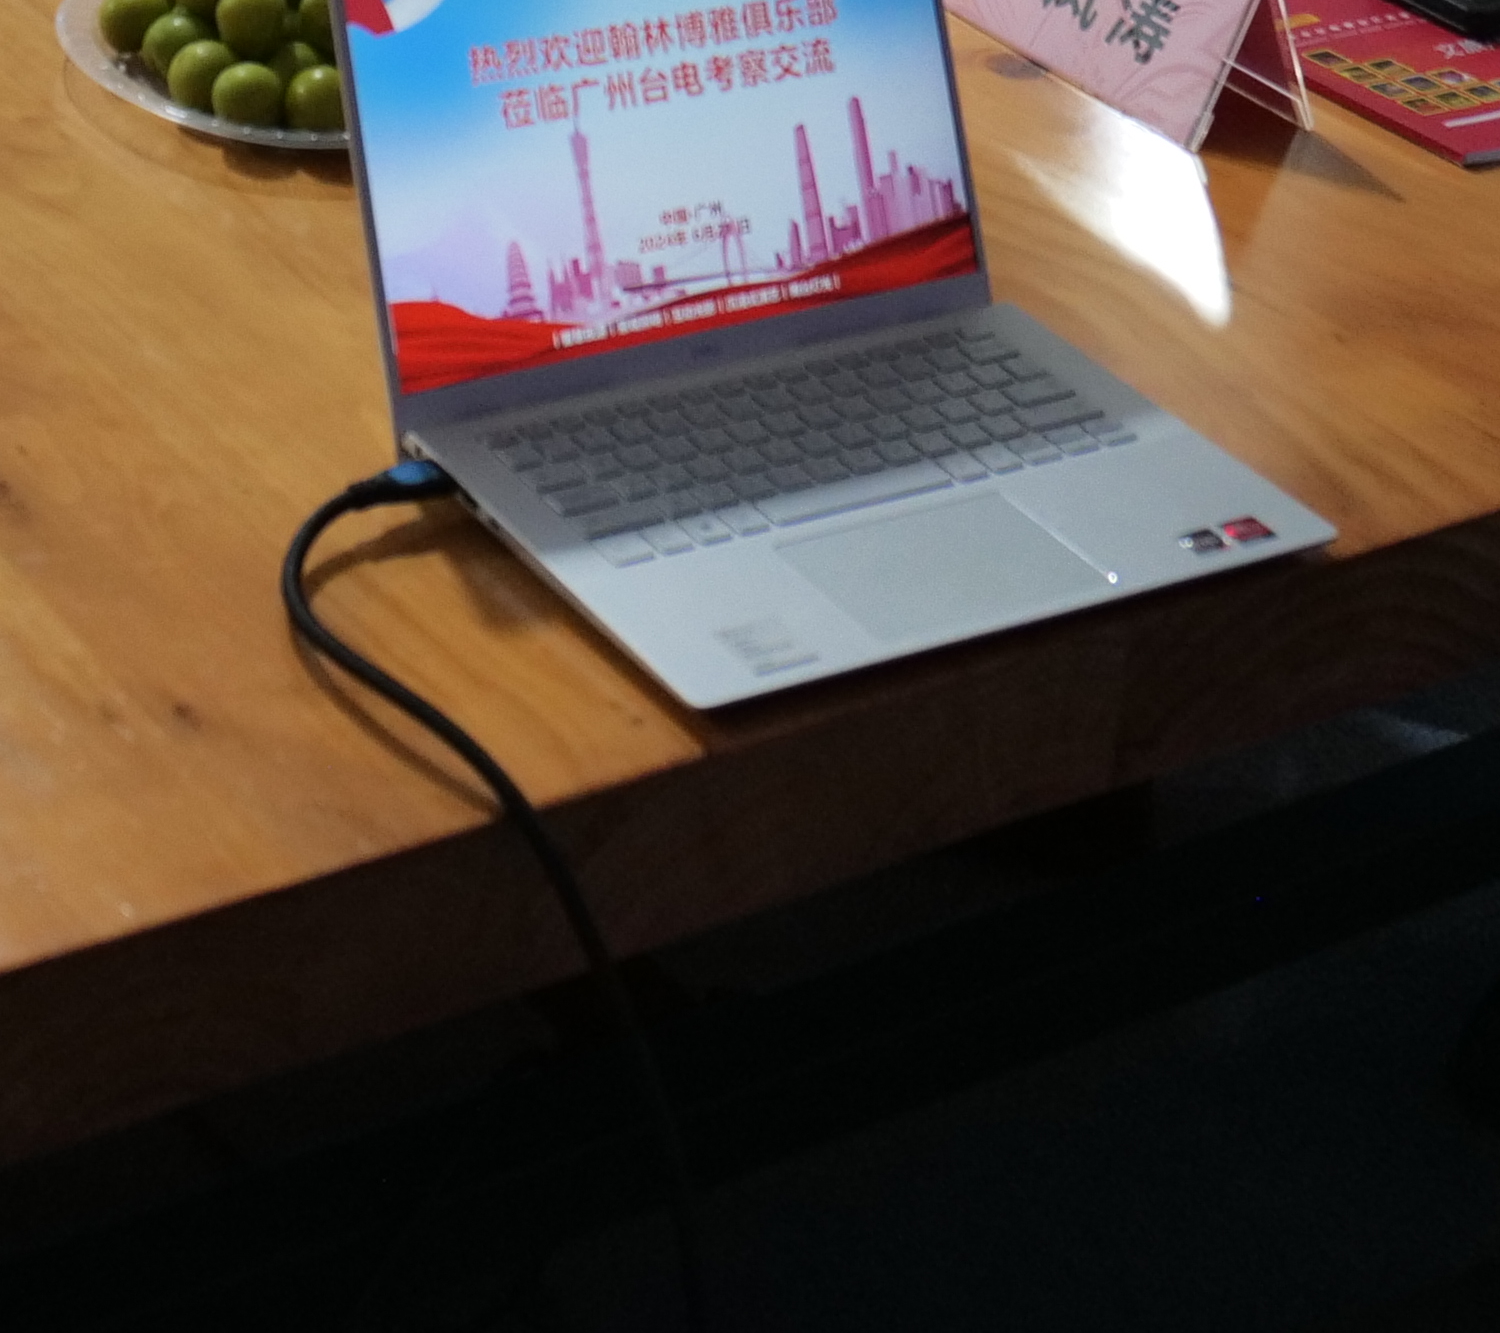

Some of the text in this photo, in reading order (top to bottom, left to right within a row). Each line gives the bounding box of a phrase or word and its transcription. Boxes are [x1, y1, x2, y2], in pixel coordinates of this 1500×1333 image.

[500, 37, 836, 129] 莅临广州台电考察交流
